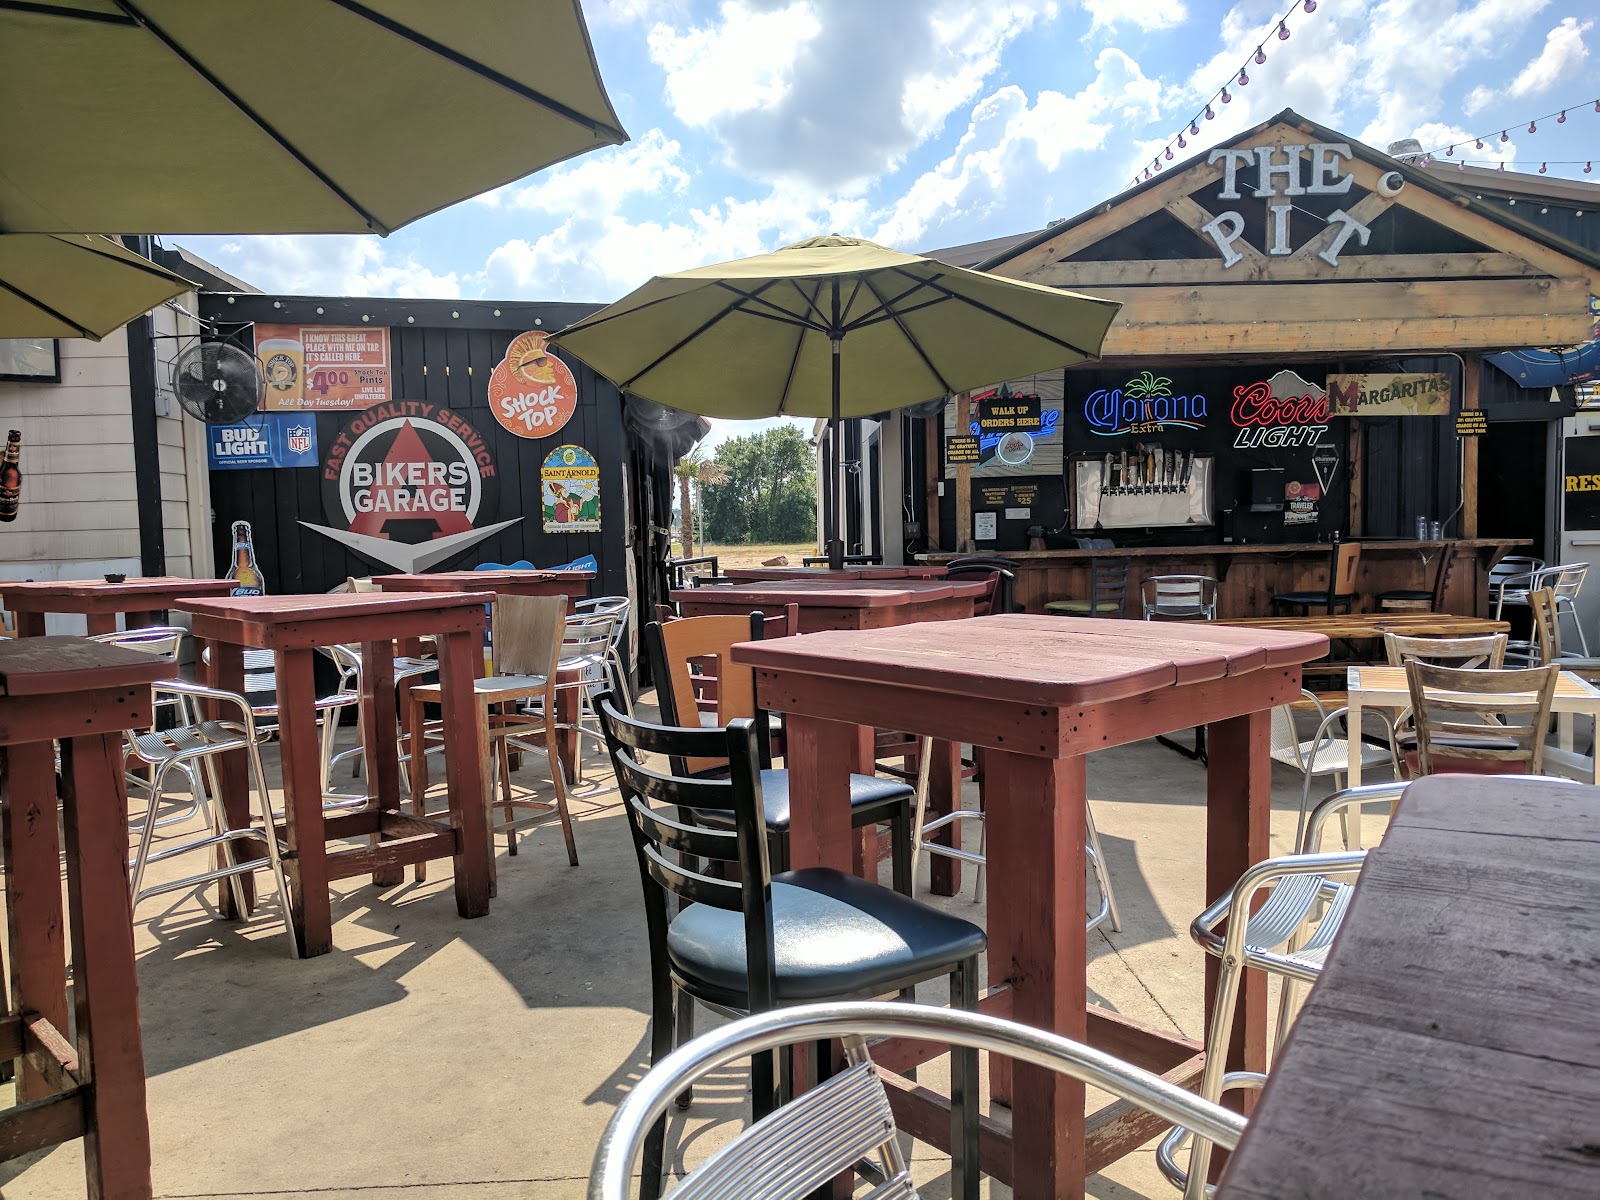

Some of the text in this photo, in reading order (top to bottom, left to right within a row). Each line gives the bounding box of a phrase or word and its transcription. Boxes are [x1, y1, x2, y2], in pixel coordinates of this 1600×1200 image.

[1207, 143, 1354, 199] THE
[1201, 209, 1371, 268] PIT
[309, 334, 329, 342] KNOW
[330, 334, 345, 342] THIS
[346, 334, 366, 342] GREAT
[306, 343, 326, 352] PLACE
[328, 343, 344, 352] WITH
[346, 343, 355, 352] ME
[356, 343, 366, 352] ON
[306, 353, 363, 362] IT'S CALLED HERE.
[360, 376, 383, 384] Pints
[1328, 376, 1450, 412] MARGARITAS
[278, 398, 355, 407] All Day Tuesday!
[500, 386, 564, 418] SHOCK
[1230, 382, 1335, 427] Coors
[992, 406, 1028, 416] WALK UP
[1084, 389, 1208, 431] Corona
[517, 406, 558, 431] TOP
[981, 418, 1040, 428] ORDERS HERE
[222, 428, 260, 442] BUD
[1130, 422, 1164, 434] Extra
[291, 438, 308, 450] NFL
[324, 402, 496, 480] FAST QUALITY SERVICE
[1233, 426, 1328, 448] LIGHT
[216, 441, 267, 456] LIGHT
[353, 462, 468, 486] BIKERS
[566, 469, 596, 478] ARNOLD
[354, 488, 466, 512] GARAGE
[1290, 502, 1314, 510] TRAVELER
